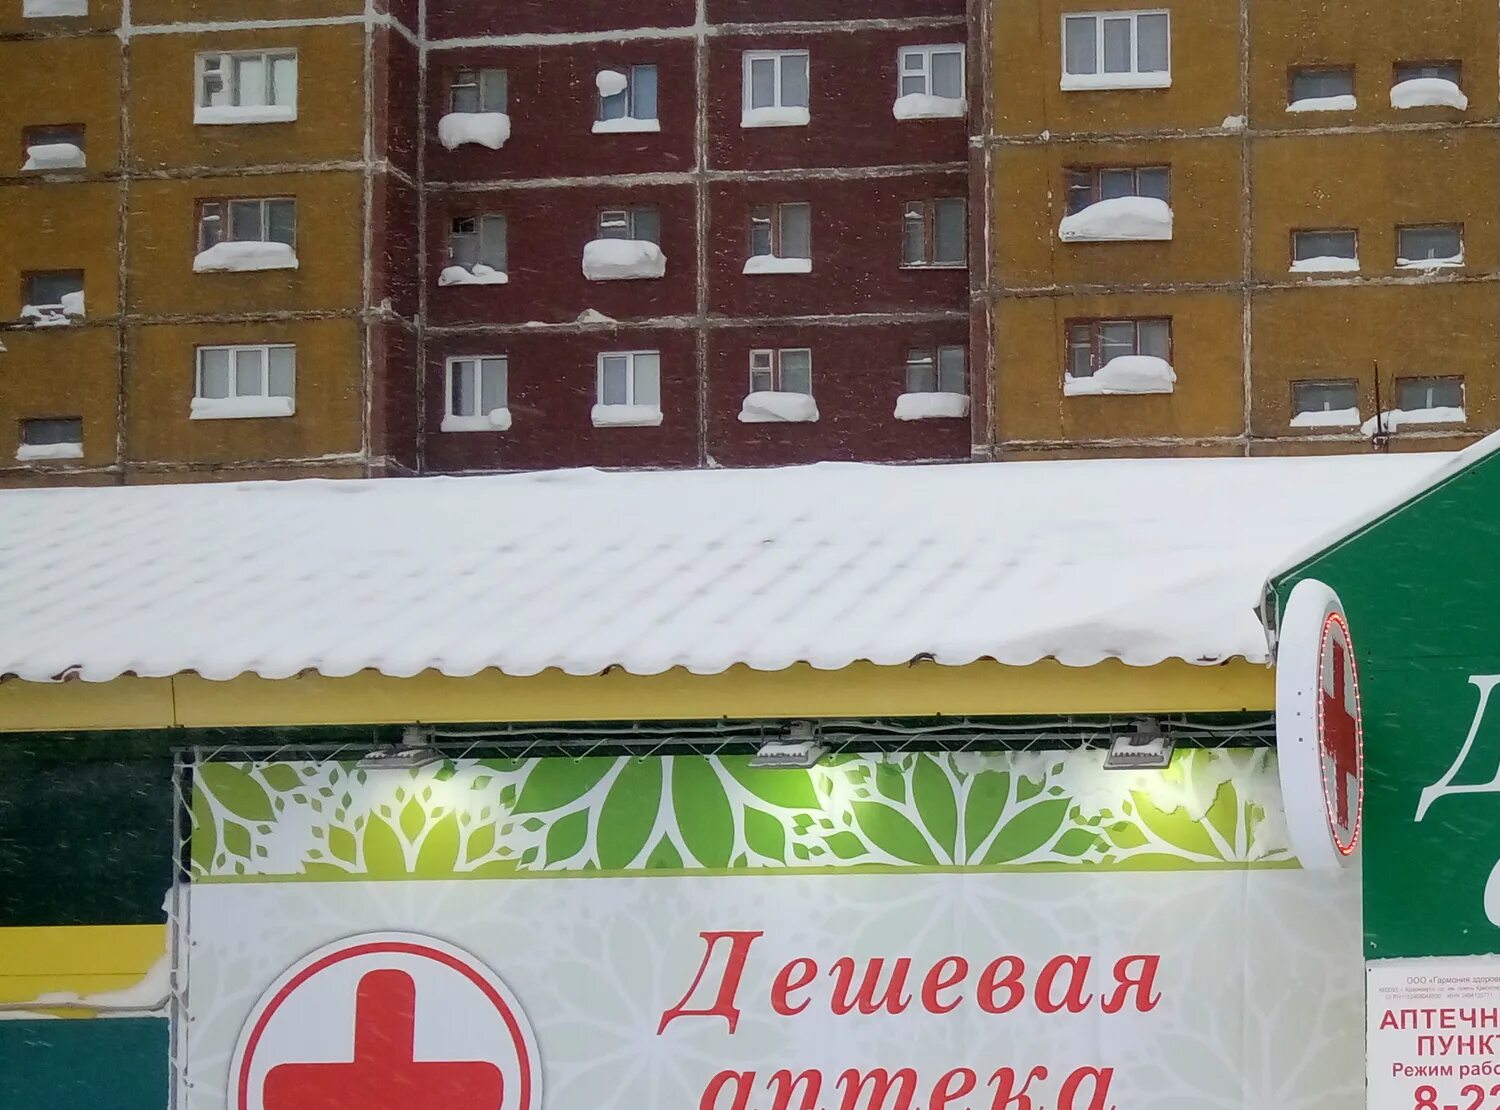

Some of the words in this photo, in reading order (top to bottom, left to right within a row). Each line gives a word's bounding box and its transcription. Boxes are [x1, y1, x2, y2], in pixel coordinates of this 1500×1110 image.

[656, 930, 1163, 1037] Дешевая
[1406, 976, 1427, 985] ООО
[1392, 1062, 1453, 1077] Режим
